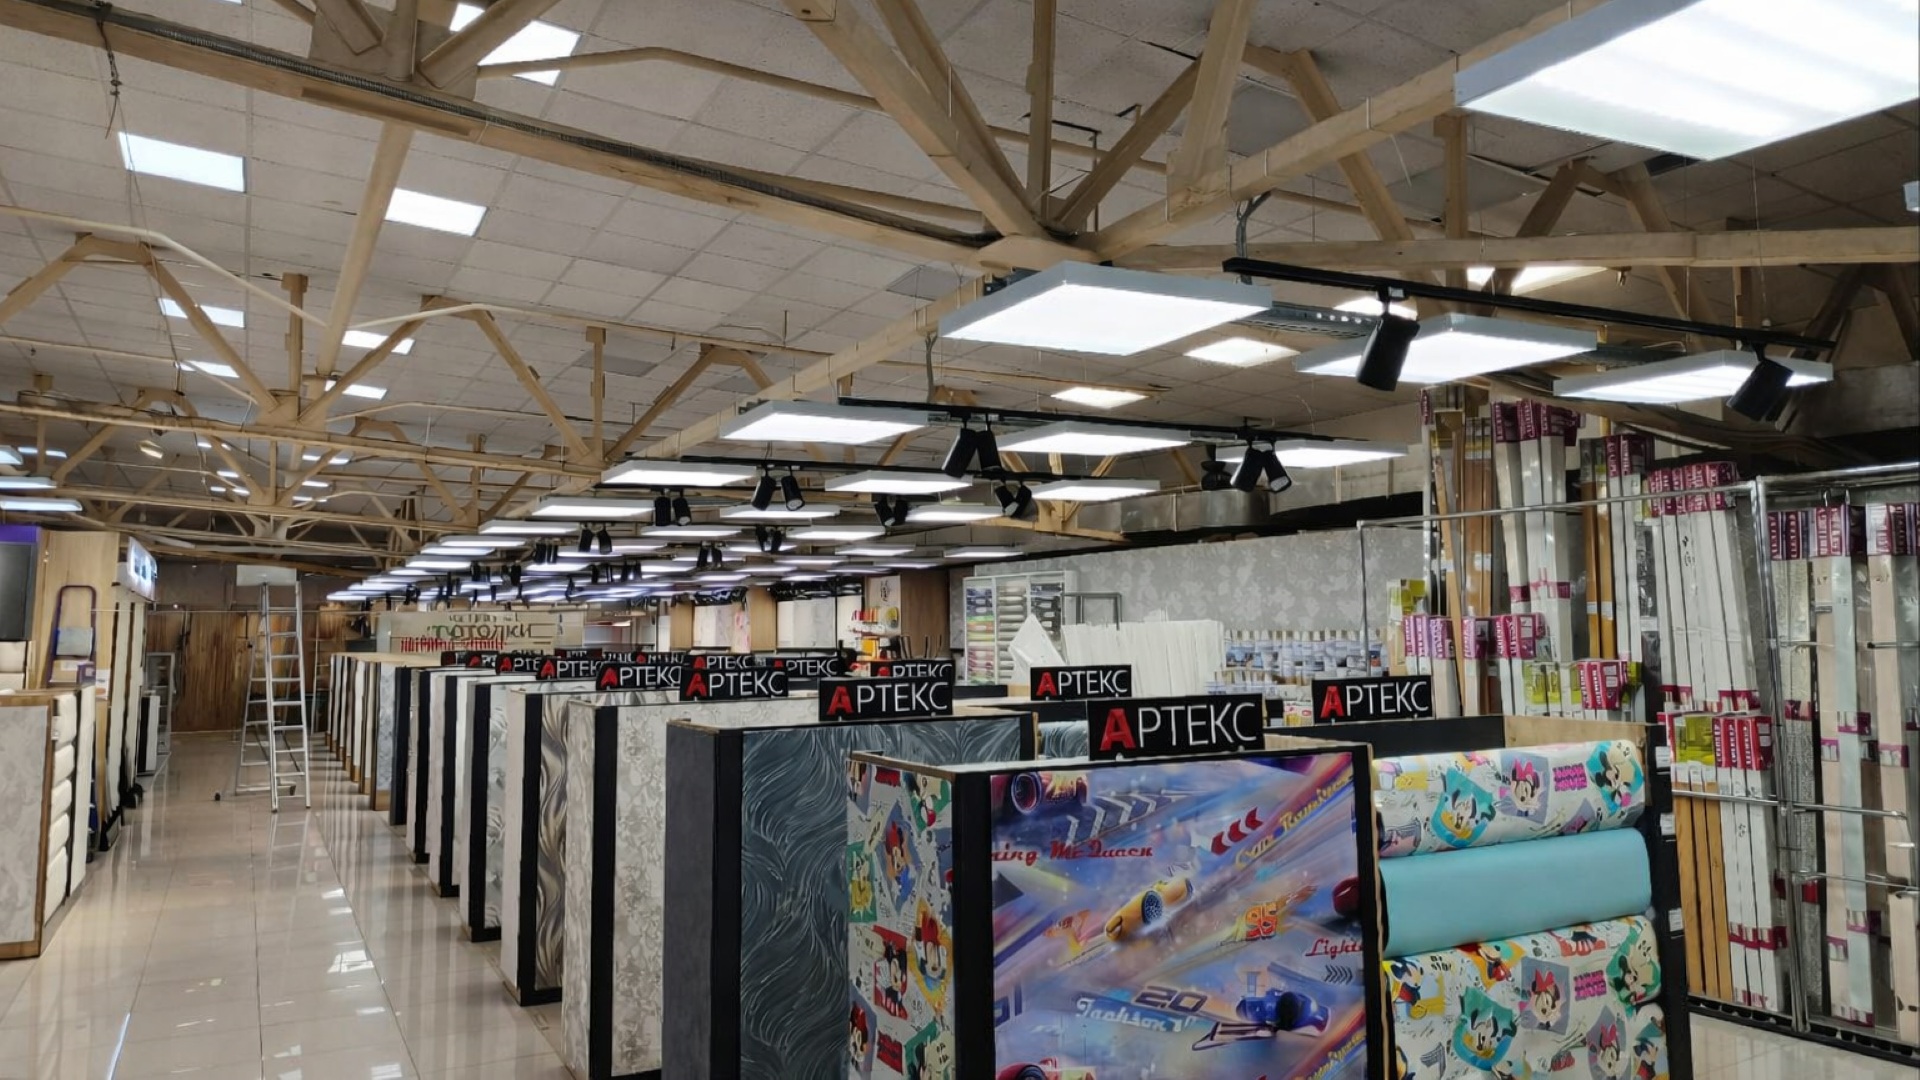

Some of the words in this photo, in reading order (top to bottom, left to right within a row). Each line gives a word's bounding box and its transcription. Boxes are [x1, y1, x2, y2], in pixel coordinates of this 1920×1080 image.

[500, 656, 540, 671] АРТЕ
[541, 660, 599, 678] АРТЕК
[601, 665, 682, 687] АРТЕКС
[686, 671, 785, 698] АРТЕКС
[1037, 668, 1129, 696] АРТЕКС
[827, 682, 948, 715] АРТЕКС
[1320, 681, 1429, 719] АРТЕКС
[1100, 702, 1257, 750] АРТЕКС
